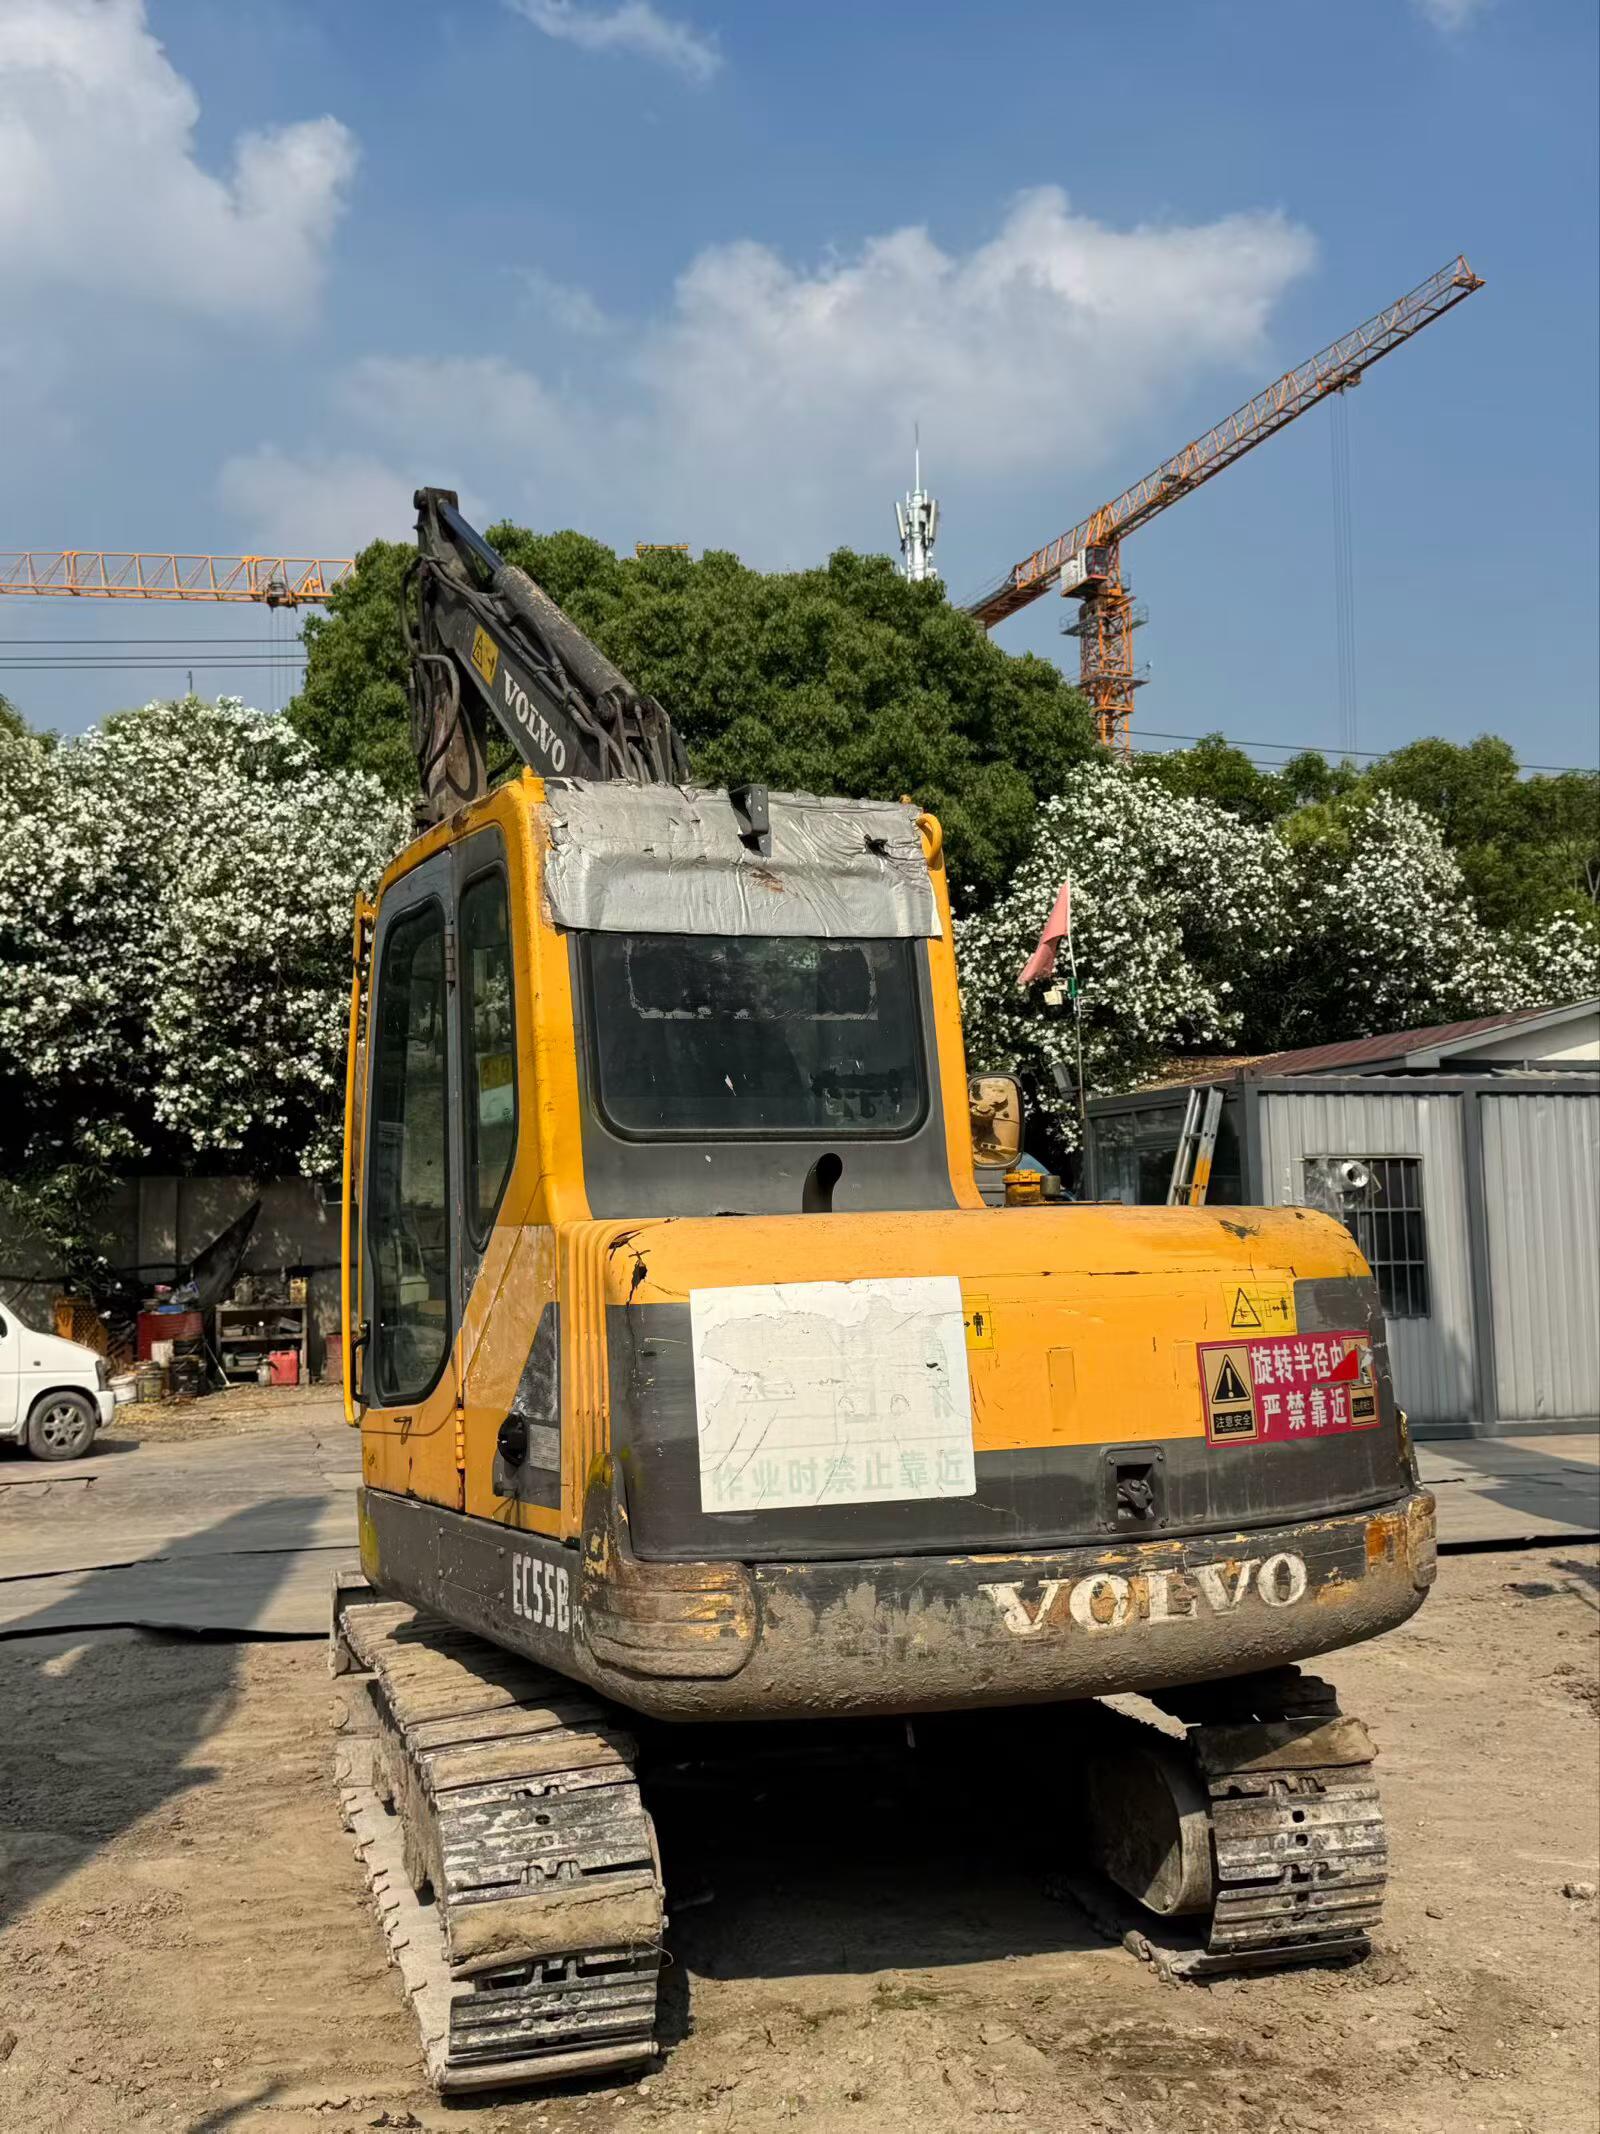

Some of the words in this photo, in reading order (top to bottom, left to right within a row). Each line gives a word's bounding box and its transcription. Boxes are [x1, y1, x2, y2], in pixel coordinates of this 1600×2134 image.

[503, 669, 566, 772] VOLVO
[1251, 1340, 1344, 1385] 旋转半径内
[1215, 1413, 1251, 1429] 注意安全
[1261, 1387, 1347, 1433] 严禁靠近
[712, 1448, 967, 1503] 作业时禁止靠近
[512, 1552, 570, 1632] EC55B
[977, 1552, 1309, 1636] VOLVO
